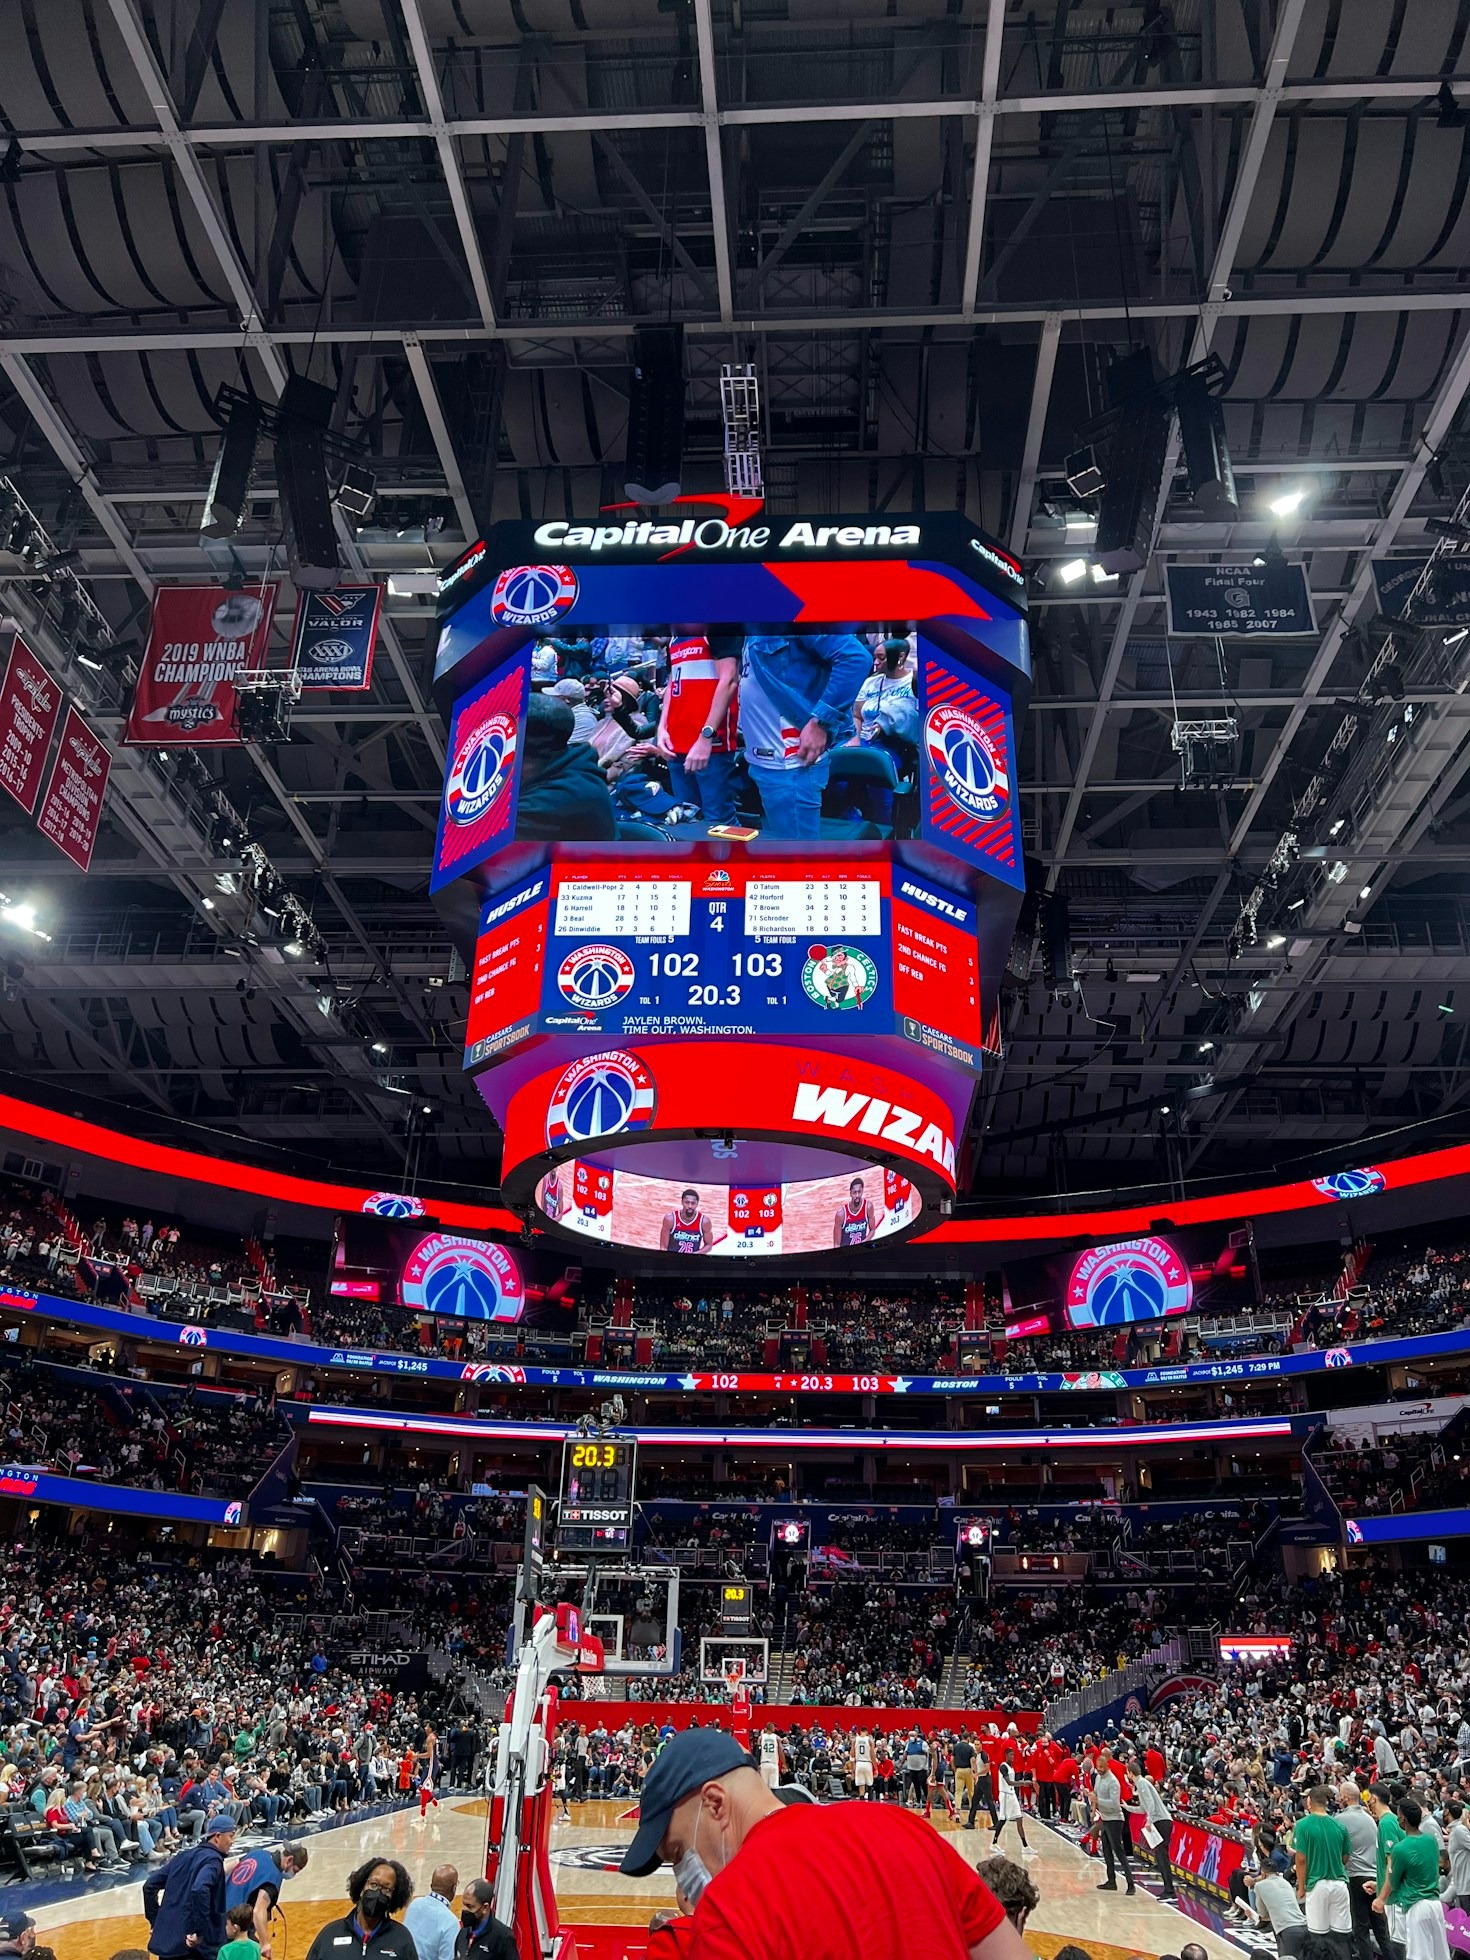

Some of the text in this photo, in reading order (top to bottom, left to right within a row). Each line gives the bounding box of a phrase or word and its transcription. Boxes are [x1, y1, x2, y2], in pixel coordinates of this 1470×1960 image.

[779, 523, 920, 547] Arena
[1205, 578, 1265, 586] Final Four
[1216, 568, 1251, 576] NCAA
[502, 607, 558, 625] WIZARDS
[1186, 609, 1295, 618] 1943 1982 1984
[1208, 620, 1277, 629] 1985 2007
[161, 642, 245, 662] 2019 WNBA
[299, 672, 362, 681] HAMPIONS
[13, 713, 36, 745] TROPHY
[462, 715, 510, 756] WASHINGTON
[938, 709, 997, 754] WASHINGTON
[6, 730, 32, 766] 2009-10
[1, 745, 28, 781] 2015-16
[0, 760, 25, 793] 2016-17
[61, 758, 99, 806] METROPOLITAN
[65, 776, 90, 809] DIVISION
[457, 774, 503, 815] WIZARDS
[944, 769, 999, 811] WIZARDS
[50, 794, 70, 819] 2015-16
[59, 784, 92, 822] CHAMPIONS
[47, 806, 68, 831] 2016-17
[43, 817, 64, 843] 2017-18
[486, 881, 543, 924] HUSTLE
[709, 902, 727, 914] QTR
[901, 881, 967, 922] HUSTLE
[710, 916, 725, 932] 4
[635, 935, 674, 944] TEAM FOULS 5
[754, 935, 797, 944] 5 TEAM FOULS
[897, 923, 973, 966] FAST BREAK PTS 5
[478, 937, 520, 966] FAST BREAK PTS
[568, 946, 626, 965] WASHINGTON
[477, 972, 488, 986] 2ND
[488, 963, 510, 980] CHANCE
[649, 953, 700, 977] 102
[732, 953, 783, 977] 103
[856, 953, 876, 992] CELTICS
[897, 943, 974, 986] 2ND CHANCE FG 3
[898, 963, 923, 982] OFF REB
[803, 960, 821, 999] BOSTON
[474, 988, 495, 1005] OFF REB
[571, 993, 618, 1008] WIZARDS
[640, 997, 651, 1005] TOL
[688, 985, 741, 1006] 20.3
[767, 997, 778, 1005] TOL
[622, 1016, 706, 1025] JAYLEN BROWN.
[622, 1026, 756, 1035] TIME OUT, WASHINGTON.
[485, 1024, 531, 1056] SPORTSBOOK
[486, 1025, 513, 1044] CAESARS
[922, 1024, 953, 1045] CAESARS
[922, 1034, 974, 1066] SPORTSBOOK
[564, 1050, 640, 1083] WASHINGTON
[575, 1184, 607, 1201] 102 103
[1340, 1184, 1379, 1198] WIZARDS
[577, 1217, 589, 1227] 20.3
[733, 1209, 775, 1218] 102 103
[755, 1227, 762, 1235] 4
[418, 1234, 512, 1275] WASHINGTON
[1076, 1237, 1171, 1281] WASHINGTON
[397, 1360, 428, 1371] $1,245
[1211, 1362, 1281, 1376] $1,245 7:29 PM
[593, 1375, 667, 1385] WASHINGTON
[711, 1375, 738, 1389] 102
[801, 1376, 833, 1390] 20.3
[852, 1377, 879, 1391] 103
[932, 1380, 979, 1389] BOSTON
[573, 1446, 615, 1467] 20.3
[581, 1510, 628, 1520] TISSOT
[724, 1588, 745, 1600] 20.3
[350, 1654, 411, 1665] ETIHAD
[763, 1743, 775, 1753] 42
[859, 1745, 865, 1754] 0
